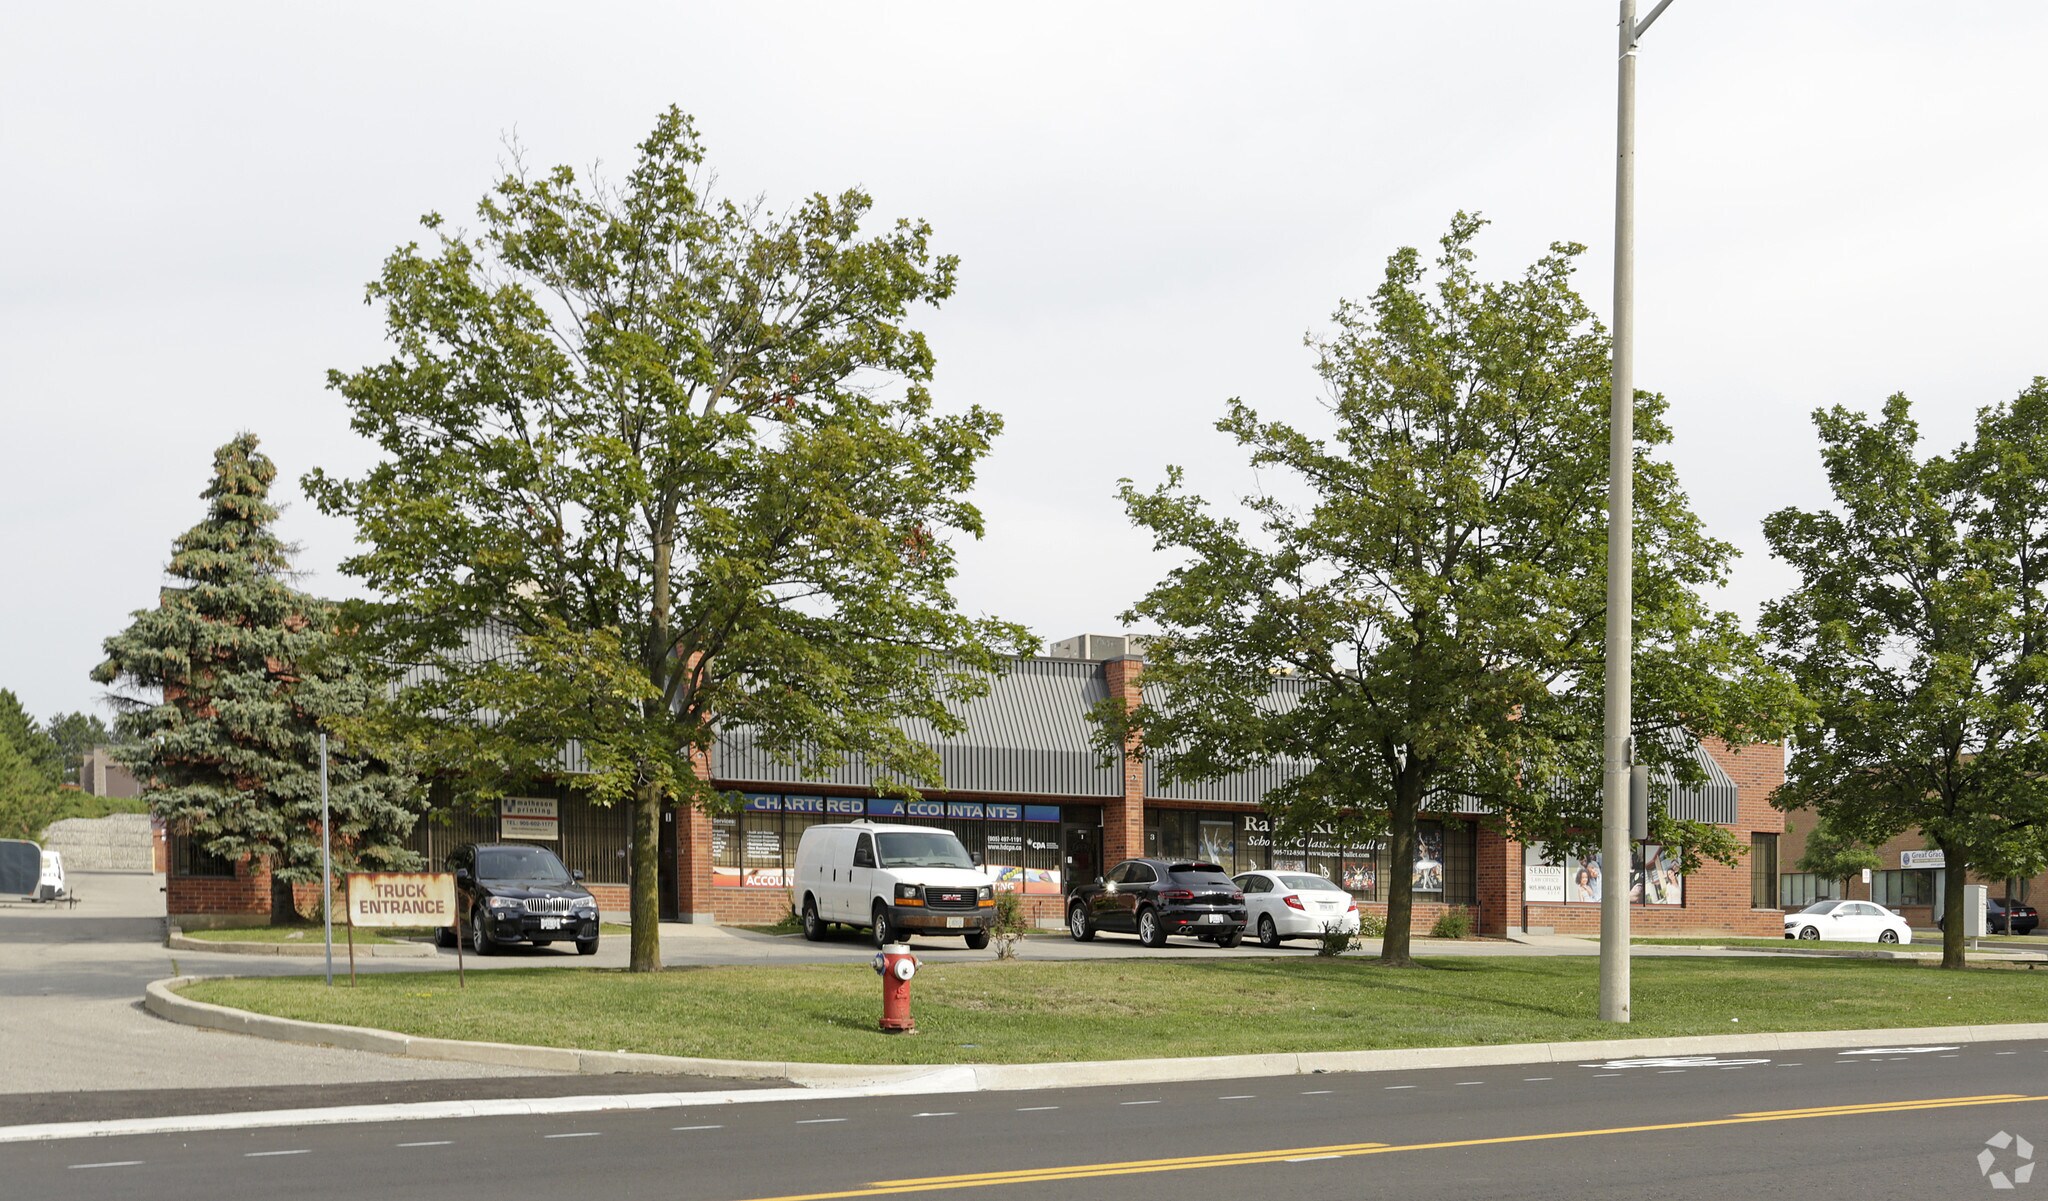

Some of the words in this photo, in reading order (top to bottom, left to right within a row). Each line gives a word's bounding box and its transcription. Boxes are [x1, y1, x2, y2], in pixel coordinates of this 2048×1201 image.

[517, 807, 551, 815] printing
[893, 801, 1017, 819] ACCOUNTANTS
[746, 876, 794, 886] ACCOUN
[375, 884, 427, 898] TRUCK
[360, 900, 445, 914] ENTRANCE
